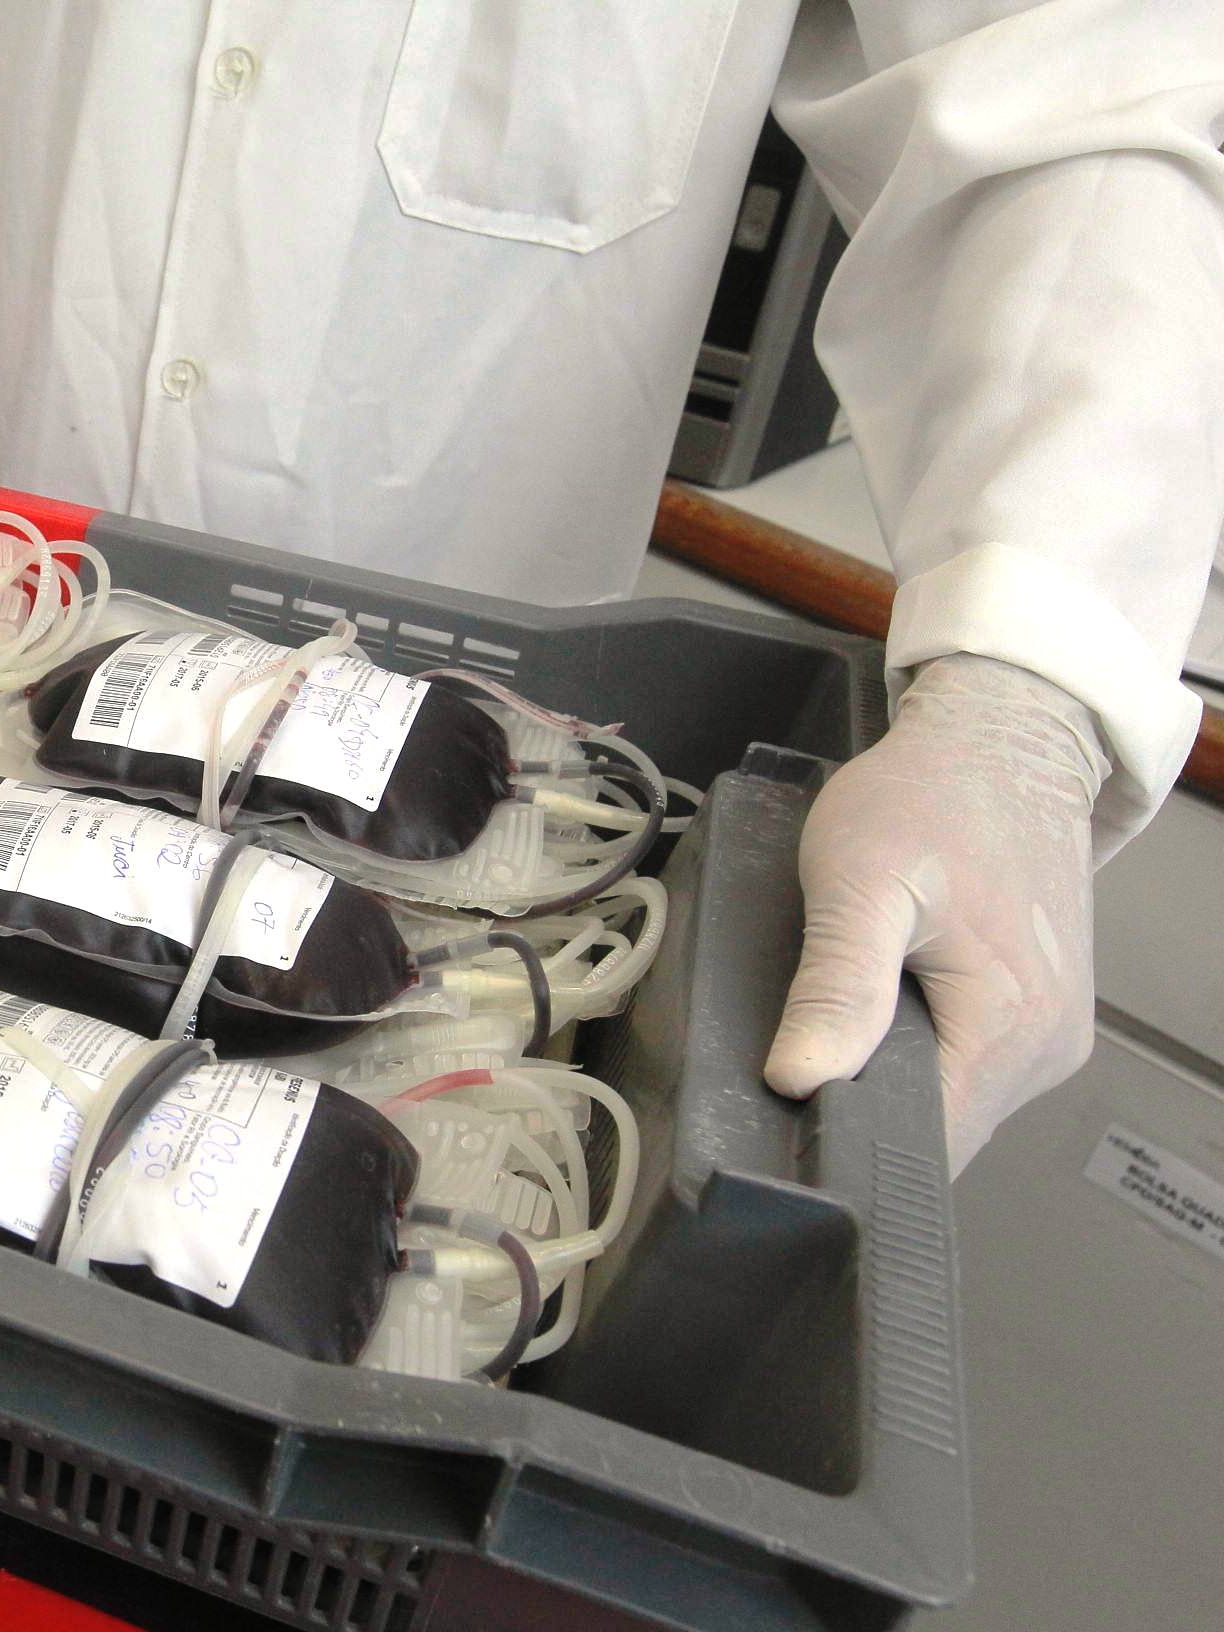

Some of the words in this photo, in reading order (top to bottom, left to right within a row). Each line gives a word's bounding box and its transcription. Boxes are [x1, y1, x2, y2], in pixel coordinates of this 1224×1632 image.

[279, 954, 288, 962] 1
[237, 1206, 261, 1247] Vencimento
[215, 1280, 228, 1291] 1
